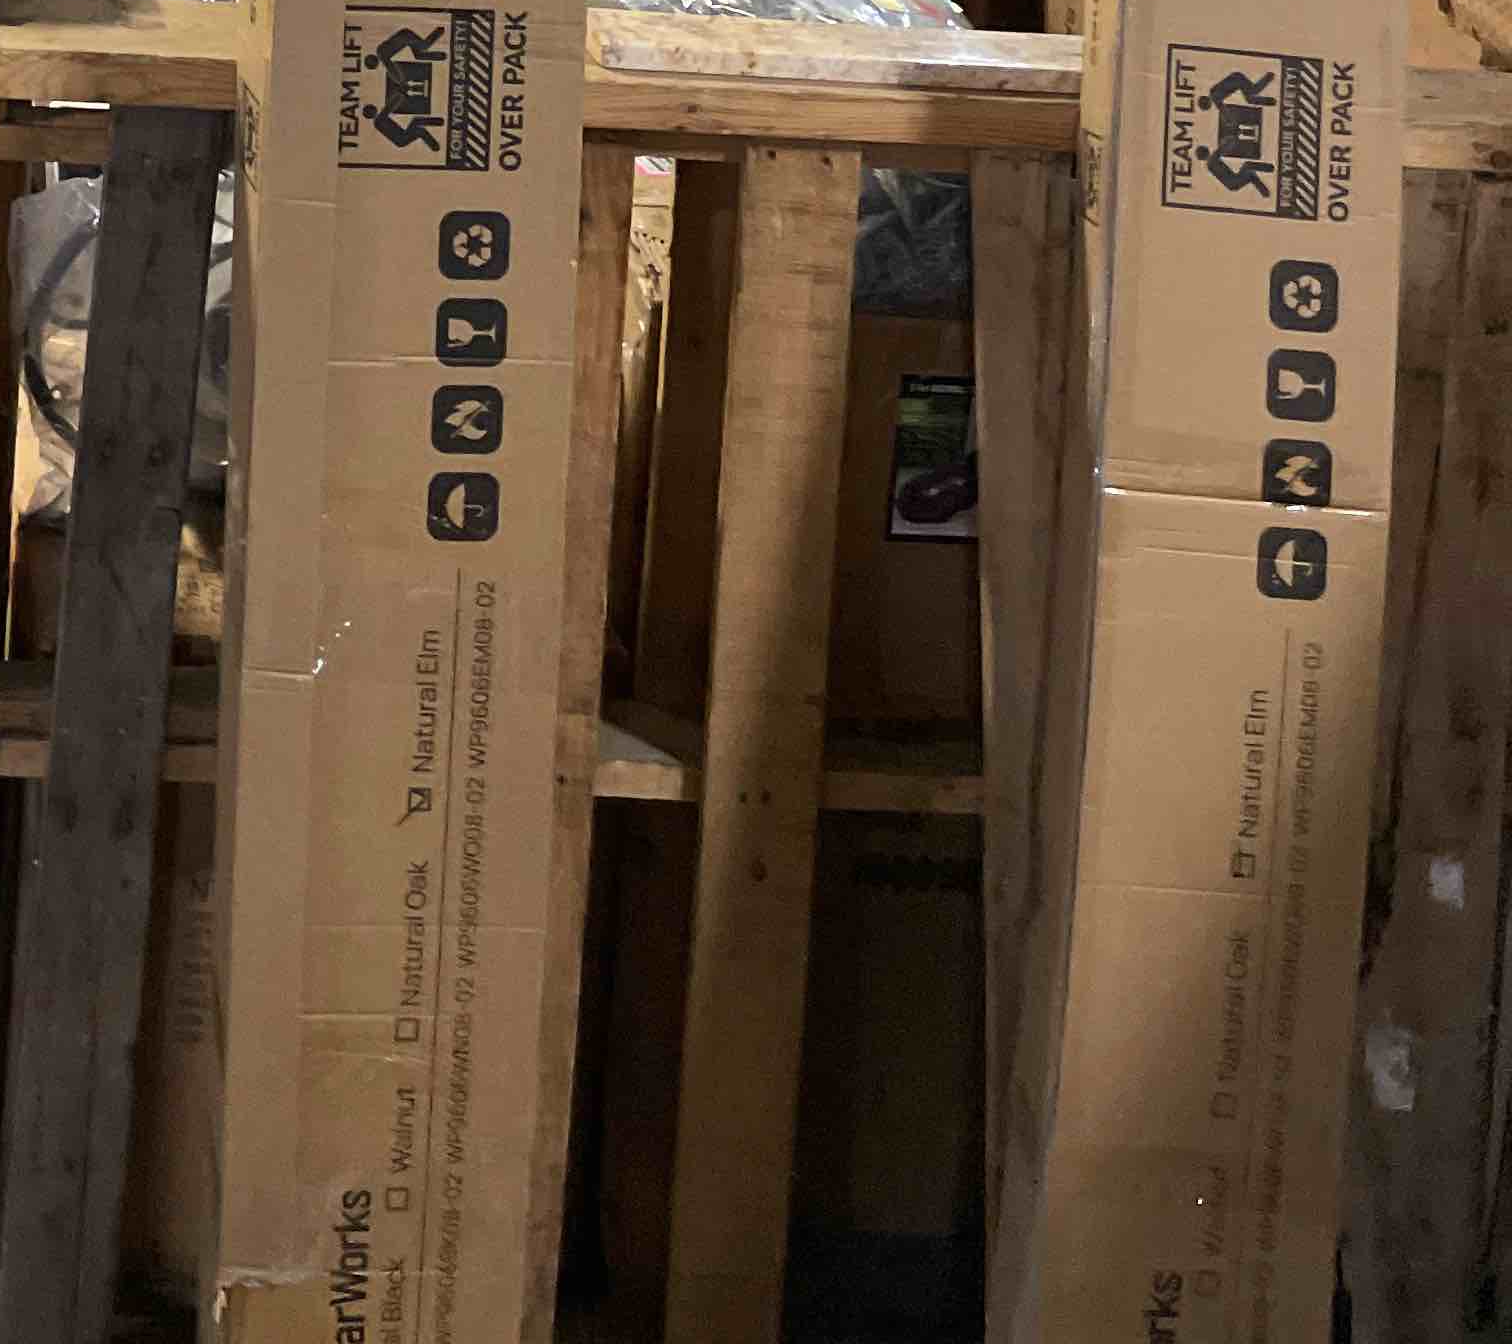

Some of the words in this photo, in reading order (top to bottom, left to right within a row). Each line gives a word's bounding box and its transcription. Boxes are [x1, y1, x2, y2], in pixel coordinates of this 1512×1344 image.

[342, 22, 363, 73] LIFT
[452, 19, 469, 80] SAFETY!
[502, 11, 529, 85] PACK
[338, 80, 362, 153] TEAM
[450, 83, 467, 127] YOUR
[1174, 58, 1197, 114] LIFT
[1331, 61, 1356, 136] PACK
[449, 127, 465, 160] FOR
[498, 94, 525, 172] OVER
[1170, 120, 1195, 193] TEAM
[1281, 132, 1295, 174] YOUR
[1279, 175, 1294, 207] FOR
[1327, 144, 1354, 222] OVER
[416, 628, 442, 675] Elm
[466, 579, 498, 770] WP9606EM08-02
[412, 681, 438, 774] Natural
[1243, 687, 1273, 738] Elm
[1237, 741, 1267, 839] Natural
[404, 859, 429, 911] Oak
[400, 915, 426, 1008] Natural
[390, 1086, 417, 1175] Walnut
[381, 1259, 406, 1323] Black
